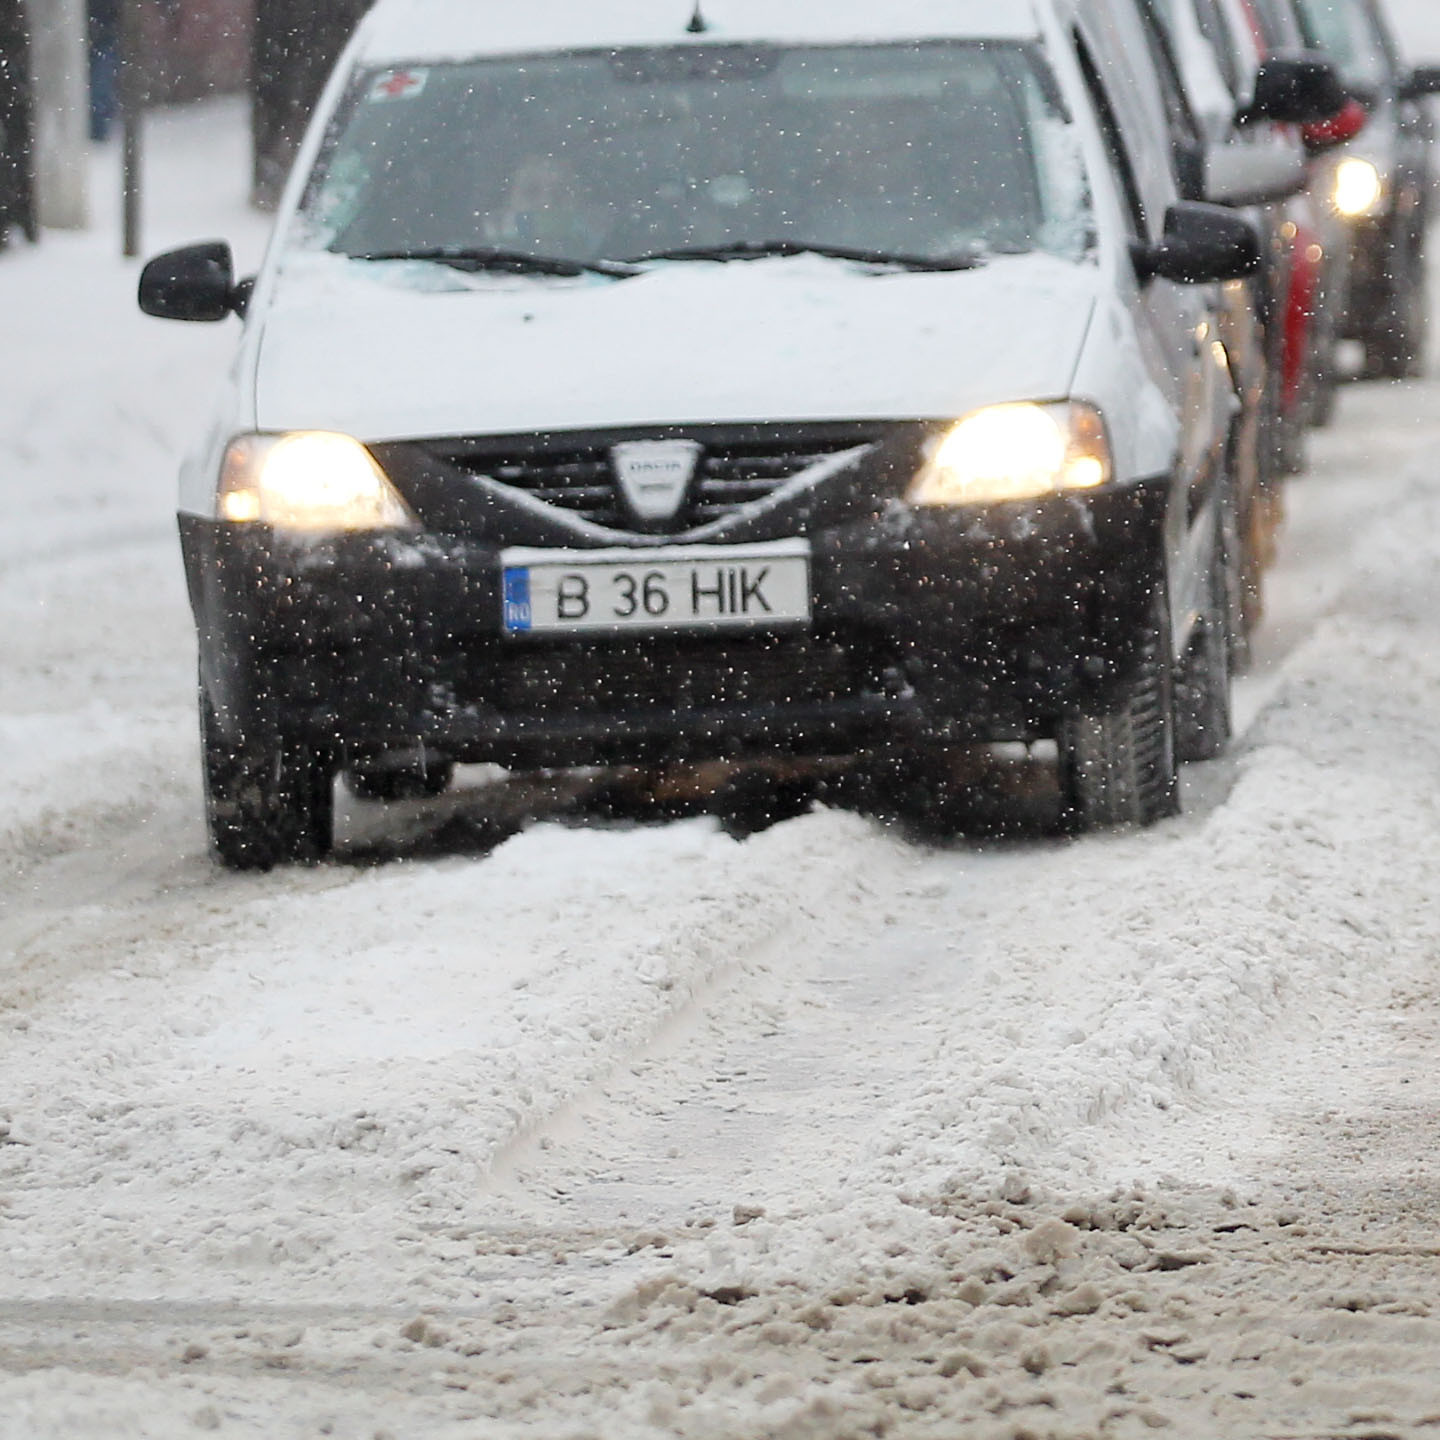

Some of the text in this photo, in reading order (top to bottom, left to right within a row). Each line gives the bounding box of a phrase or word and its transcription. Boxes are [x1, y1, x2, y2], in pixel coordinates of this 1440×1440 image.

[556, 567, 773, 620] B 36 HIK
